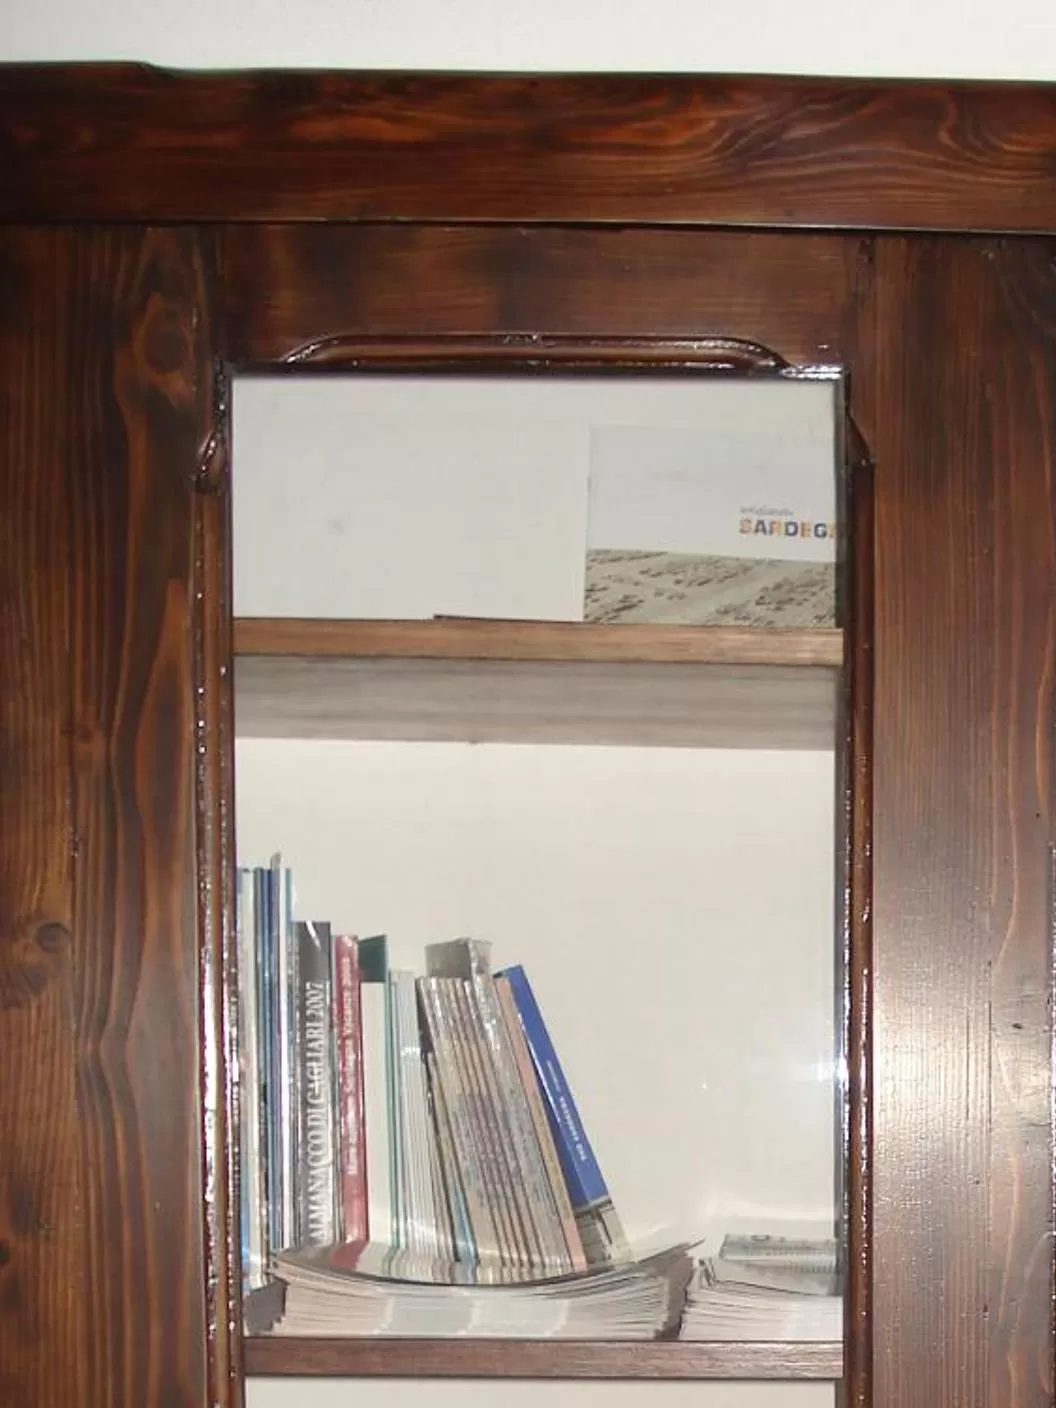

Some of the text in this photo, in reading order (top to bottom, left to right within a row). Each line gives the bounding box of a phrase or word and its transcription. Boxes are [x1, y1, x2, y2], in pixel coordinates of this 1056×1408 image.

[304, 980, 328, 1242] ALMANACCO DI CAGLIARI 2007
